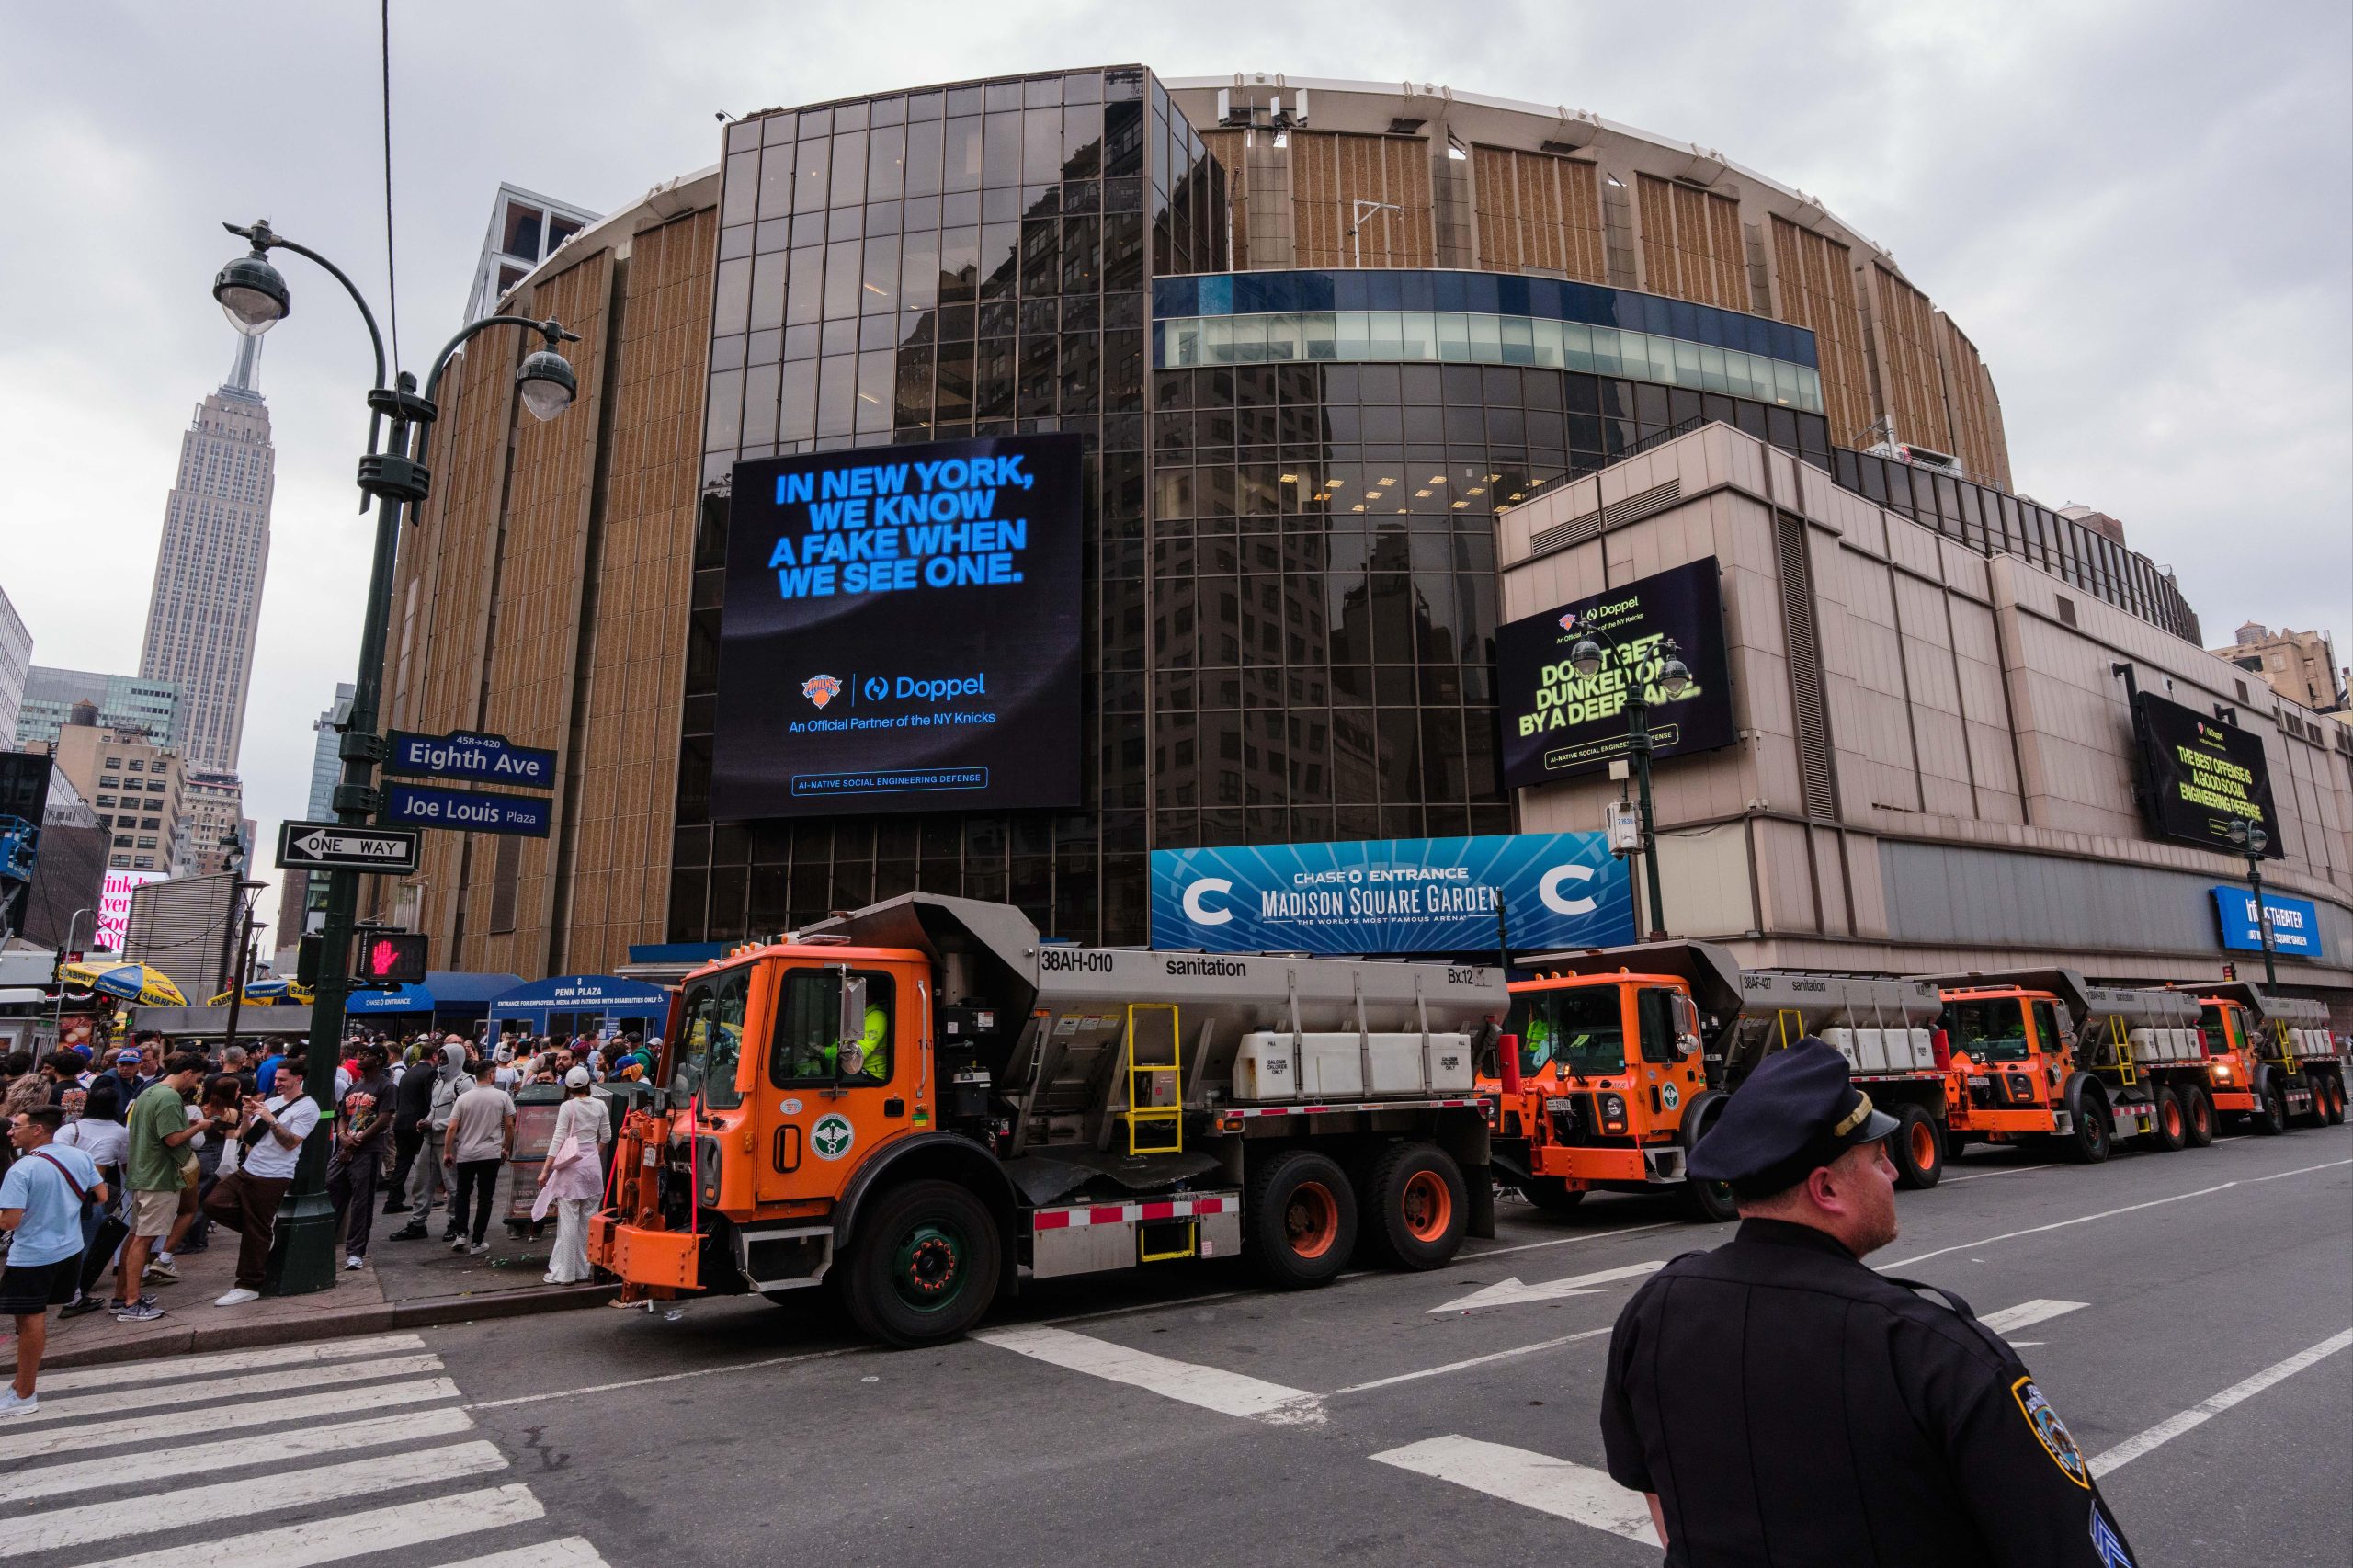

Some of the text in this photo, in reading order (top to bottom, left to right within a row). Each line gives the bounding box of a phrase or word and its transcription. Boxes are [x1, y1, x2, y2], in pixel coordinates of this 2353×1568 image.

[775, 455, 1034, 505] IN NEW YORK,
[809, 490, 995, 531] WE KNOW
[768, 518, 1027, 568] A FAKE WHEN
[778, 553, 1025, 599] WE SEE ONE.
[1600, 596, 1639, 617] Doppel
[1625, 613, 1644, 622] Knicks
[1614, 633, 1665, 666] GET
[896, 673, 985, 701] Doppel
[1536, 669, 1632, 711] DUNKED
[789, 711, 996, 733] An Official Partner of the NY Knicks
[1518, 710, 1548, 737] BY
[1549, 707, 1567, 730] A
[457, 736, 501, 749] 458 420
[1550, 752, 1578, 764] AI-NATIVE
[1578, 747, 1600, 757] SOCIAL
[409, 743, 540, 777] Eighth Ave
[2177, 745, 2253, 785] THE BEST OFFENSE IS
[799, 774, 981, 790] AI-NATIVE SOCIAL ENGINEERING DEFENSE
[2193, 768, 2248, 800] A GOOD SOCIAL
[404, 796, 537, 824] Joe Louis Plaza
[2179, 781, 2232, 812] ENGINEERING
[308, 837, 398, 855] ONE WAY
[1294, 868, 1469, 884] CHASE ENTRANCE
[1317, 917, 1358, 926] WORLD'S
[2270, 908, 2303, 929] THEATER
[1041, 951, 1473, 984] 38AH-010 sanitation Bx.12
[555, 987, 602, 996] PENN PLAZA
[1792, 979, 1826, 993] sanitation
